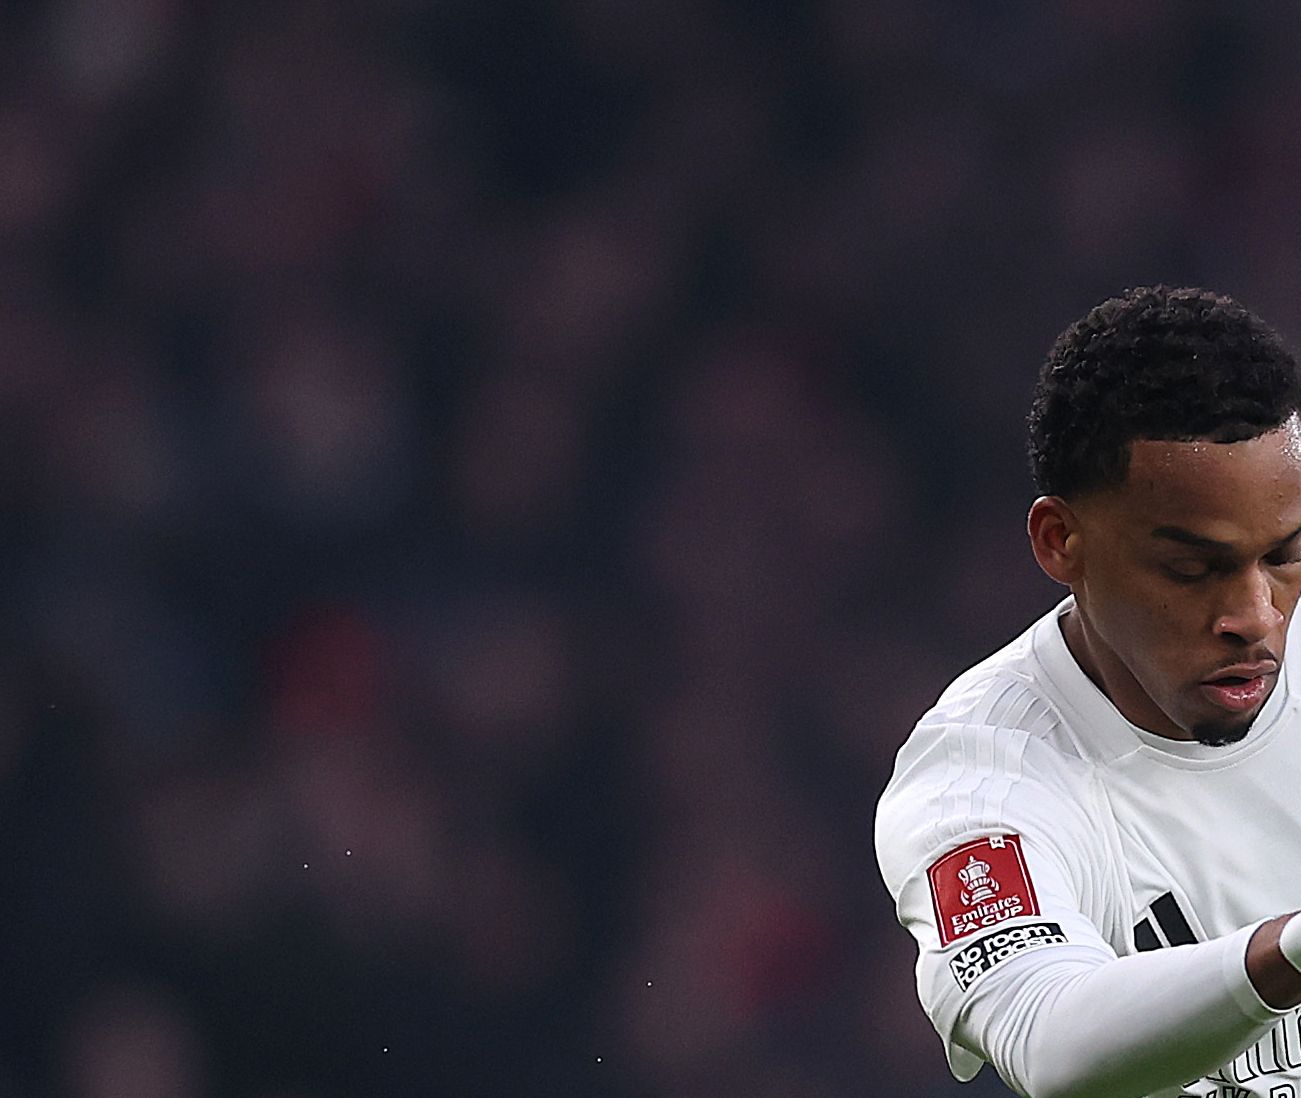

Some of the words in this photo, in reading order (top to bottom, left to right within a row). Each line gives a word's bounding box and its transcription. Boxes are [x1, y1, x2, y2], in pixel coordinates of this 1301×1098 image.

[951, 894, 1021, 926] Emirates
[953, 921, 979, 935] FA
[981, 905, 1024, 926] CUP
[950, 947, 982, 971] No
[983, 925, 1052, 952] room
[956, 958, 989, 987] for
[987, 934, 1068, 967] racism
